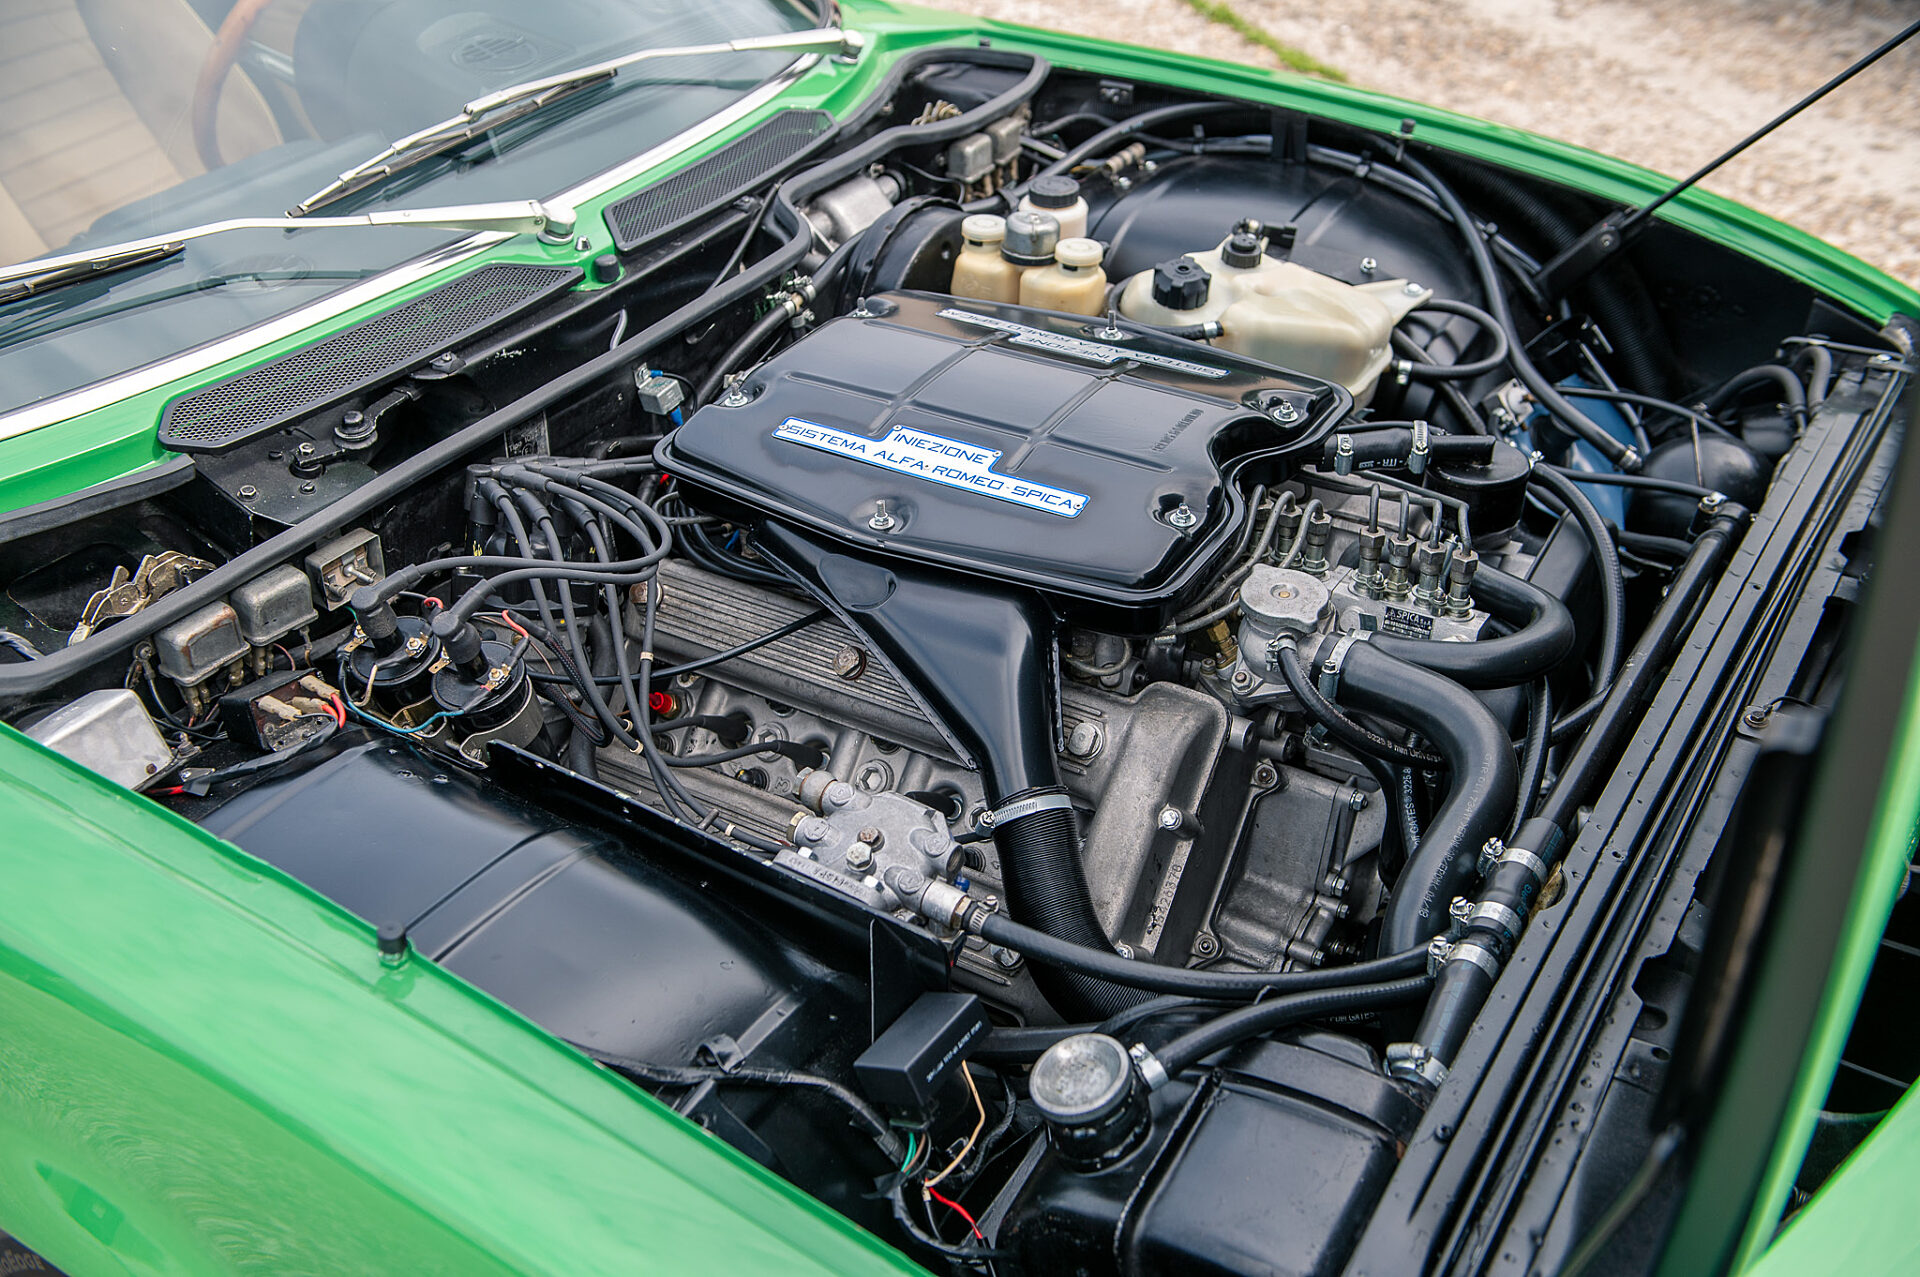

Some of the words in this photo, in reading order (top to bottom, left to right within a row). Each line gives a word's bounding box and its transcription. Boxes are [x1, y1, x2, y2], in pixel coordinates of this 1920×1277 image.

[893, 432, 988, 465] INIEZIONE
[787, 424, 867, 453] SISTEMA
[873, 449, 924, 470] ALFA
[931, 465, 1005, 490] ROMEO
[1011, 485, 1073, 508] SPICA
[1397, 609, 1420, 623] SPICA
[1403, 775, 1413, 795] 3225
